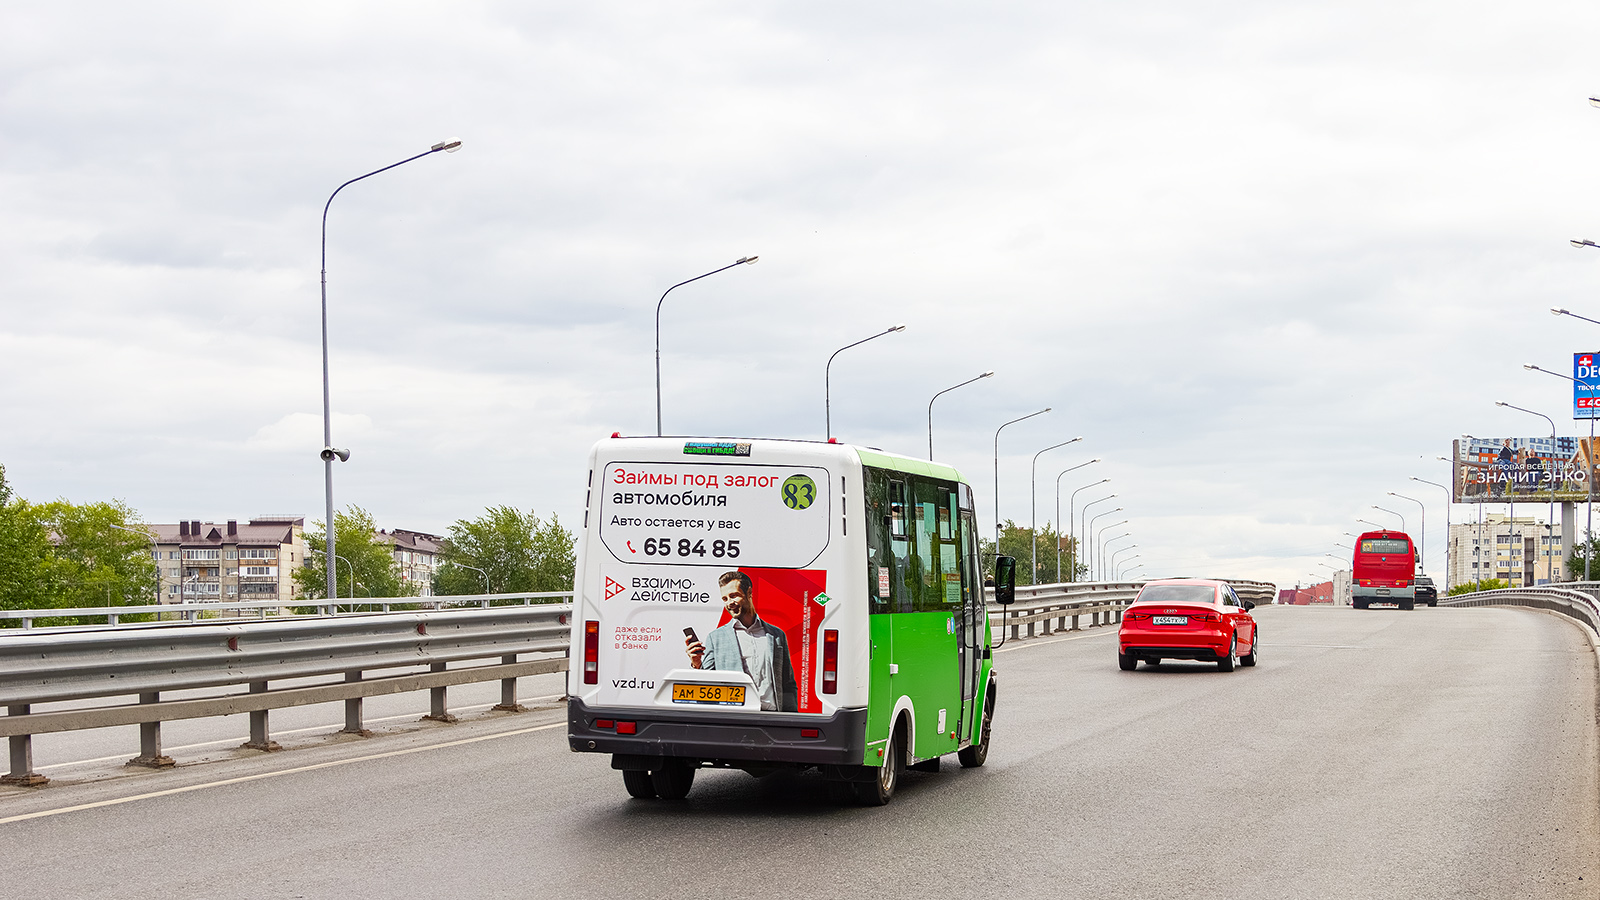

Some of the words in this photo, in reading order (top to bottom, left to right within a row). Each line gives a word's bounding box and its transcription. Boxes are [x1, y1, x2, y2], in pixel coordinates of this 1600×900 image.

[1577, 365, 1600, 378] DE
[1488, 463, 1525, 471] ИГРОВАЯ
[613, 468, 678, 486] Займы
[683, 474, 719, 489] под
[723, 475, 779, 488] залог
[1476, 471, 1540, 483] ЗНАЧИТ
[1541, 470, 1586, 482] ЭНКО
[612, 490, 727, 507] автомобиля
[783, 483, 814, 510] 83
[610, 515, 642, 527] Авто
[644, 517, 704, 528] остается
[707, 519, 715, 532] у
[718, 520, 741, 530] вас
[643, 537, 671, 557] 65
[677, 538, 707, 558] 84
[712, 539, 740, 559] 85
[615, 626, 638, 634] даже
[615, 634, 662, 642] отказали
[622, 641, 649, 650] банке
[612, 677, 655, 689] vzd.ru
[699, 687, 722, 699] 568
[729, 687, 741, 697] 72
